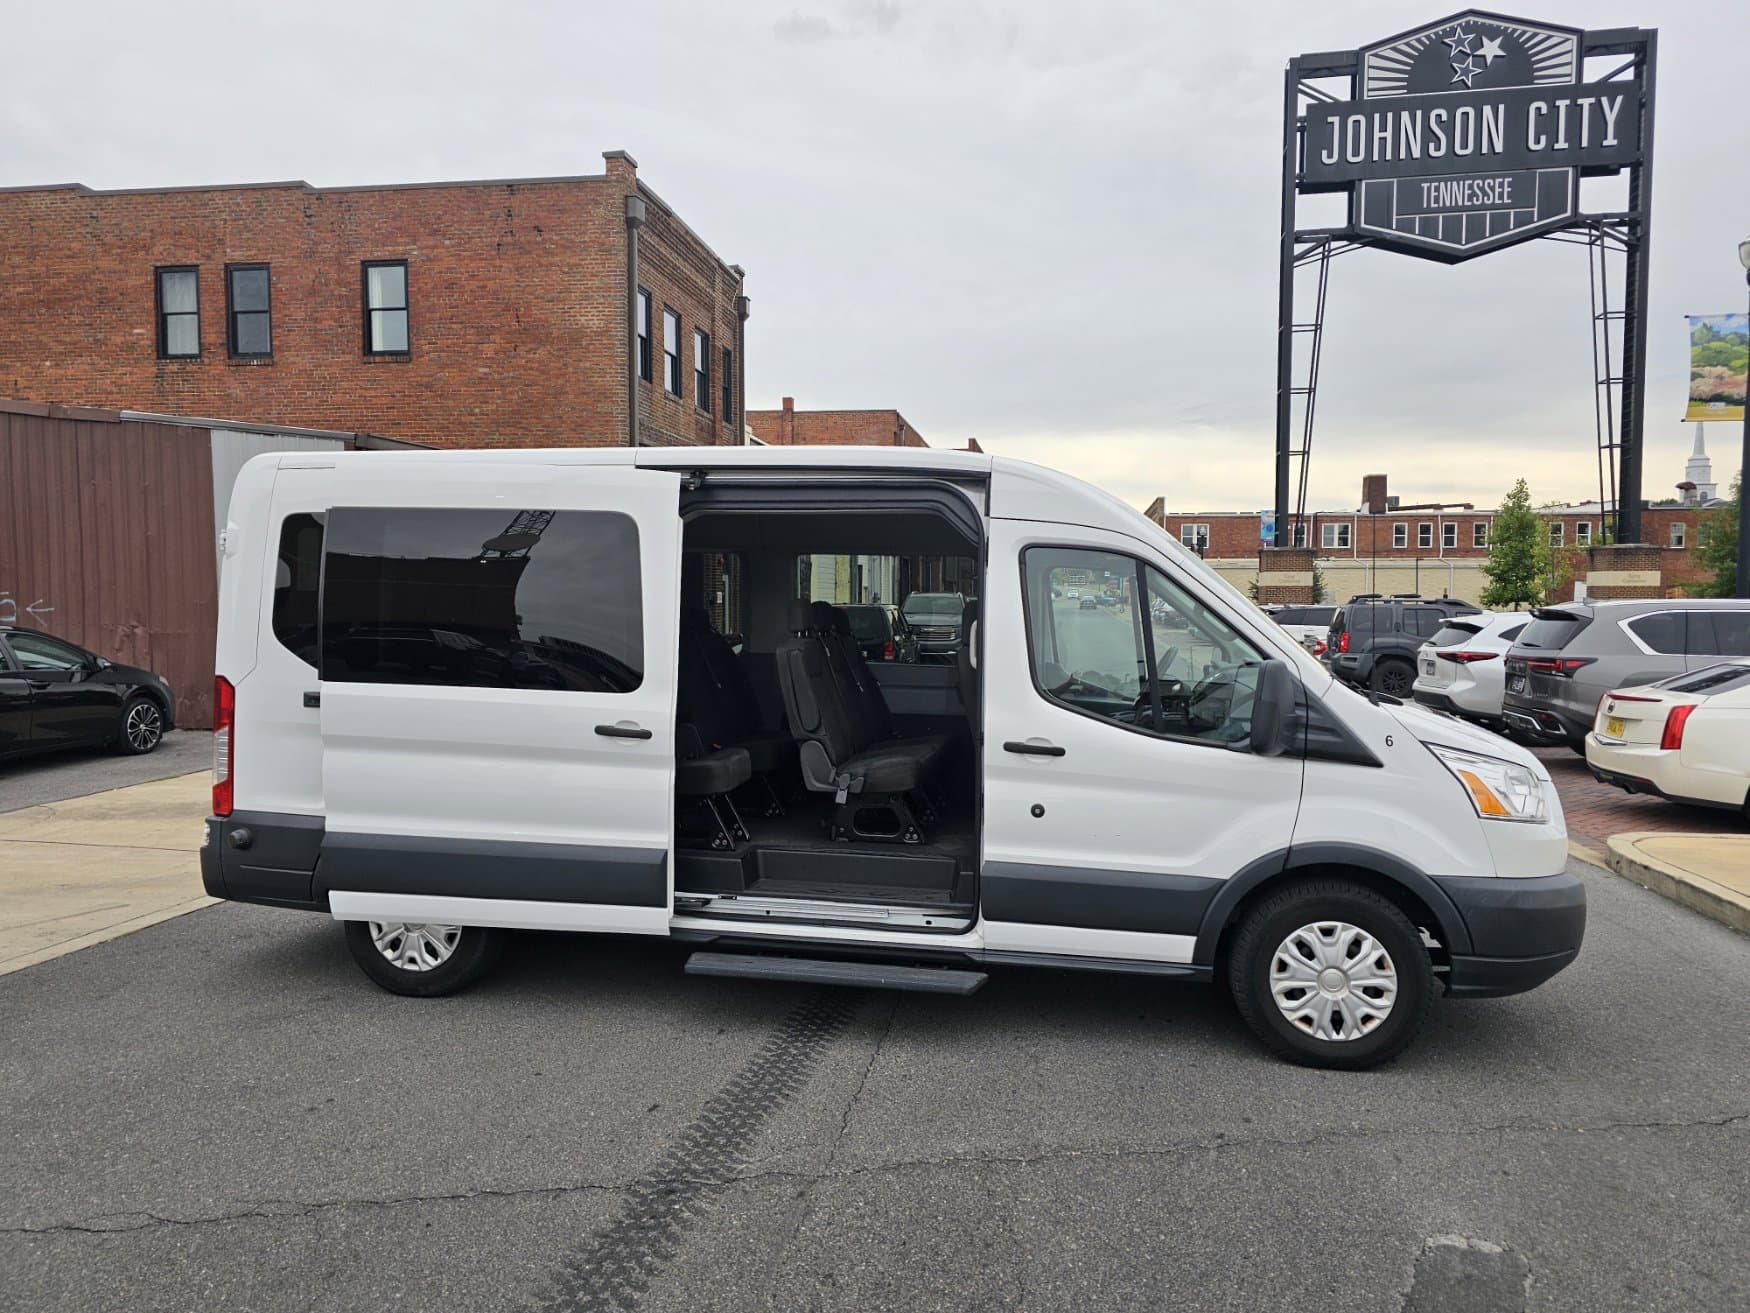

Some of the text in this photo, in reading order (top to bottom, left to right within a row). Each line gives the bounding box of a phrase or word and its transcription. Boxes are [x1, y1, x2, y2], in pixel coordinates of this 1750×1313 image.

[1320, 95, 1624, 166] JOHNSON CITY
[1420, 177, 1513, 209] TENNESSEE
[1385, 735, 1394, 747] 6
